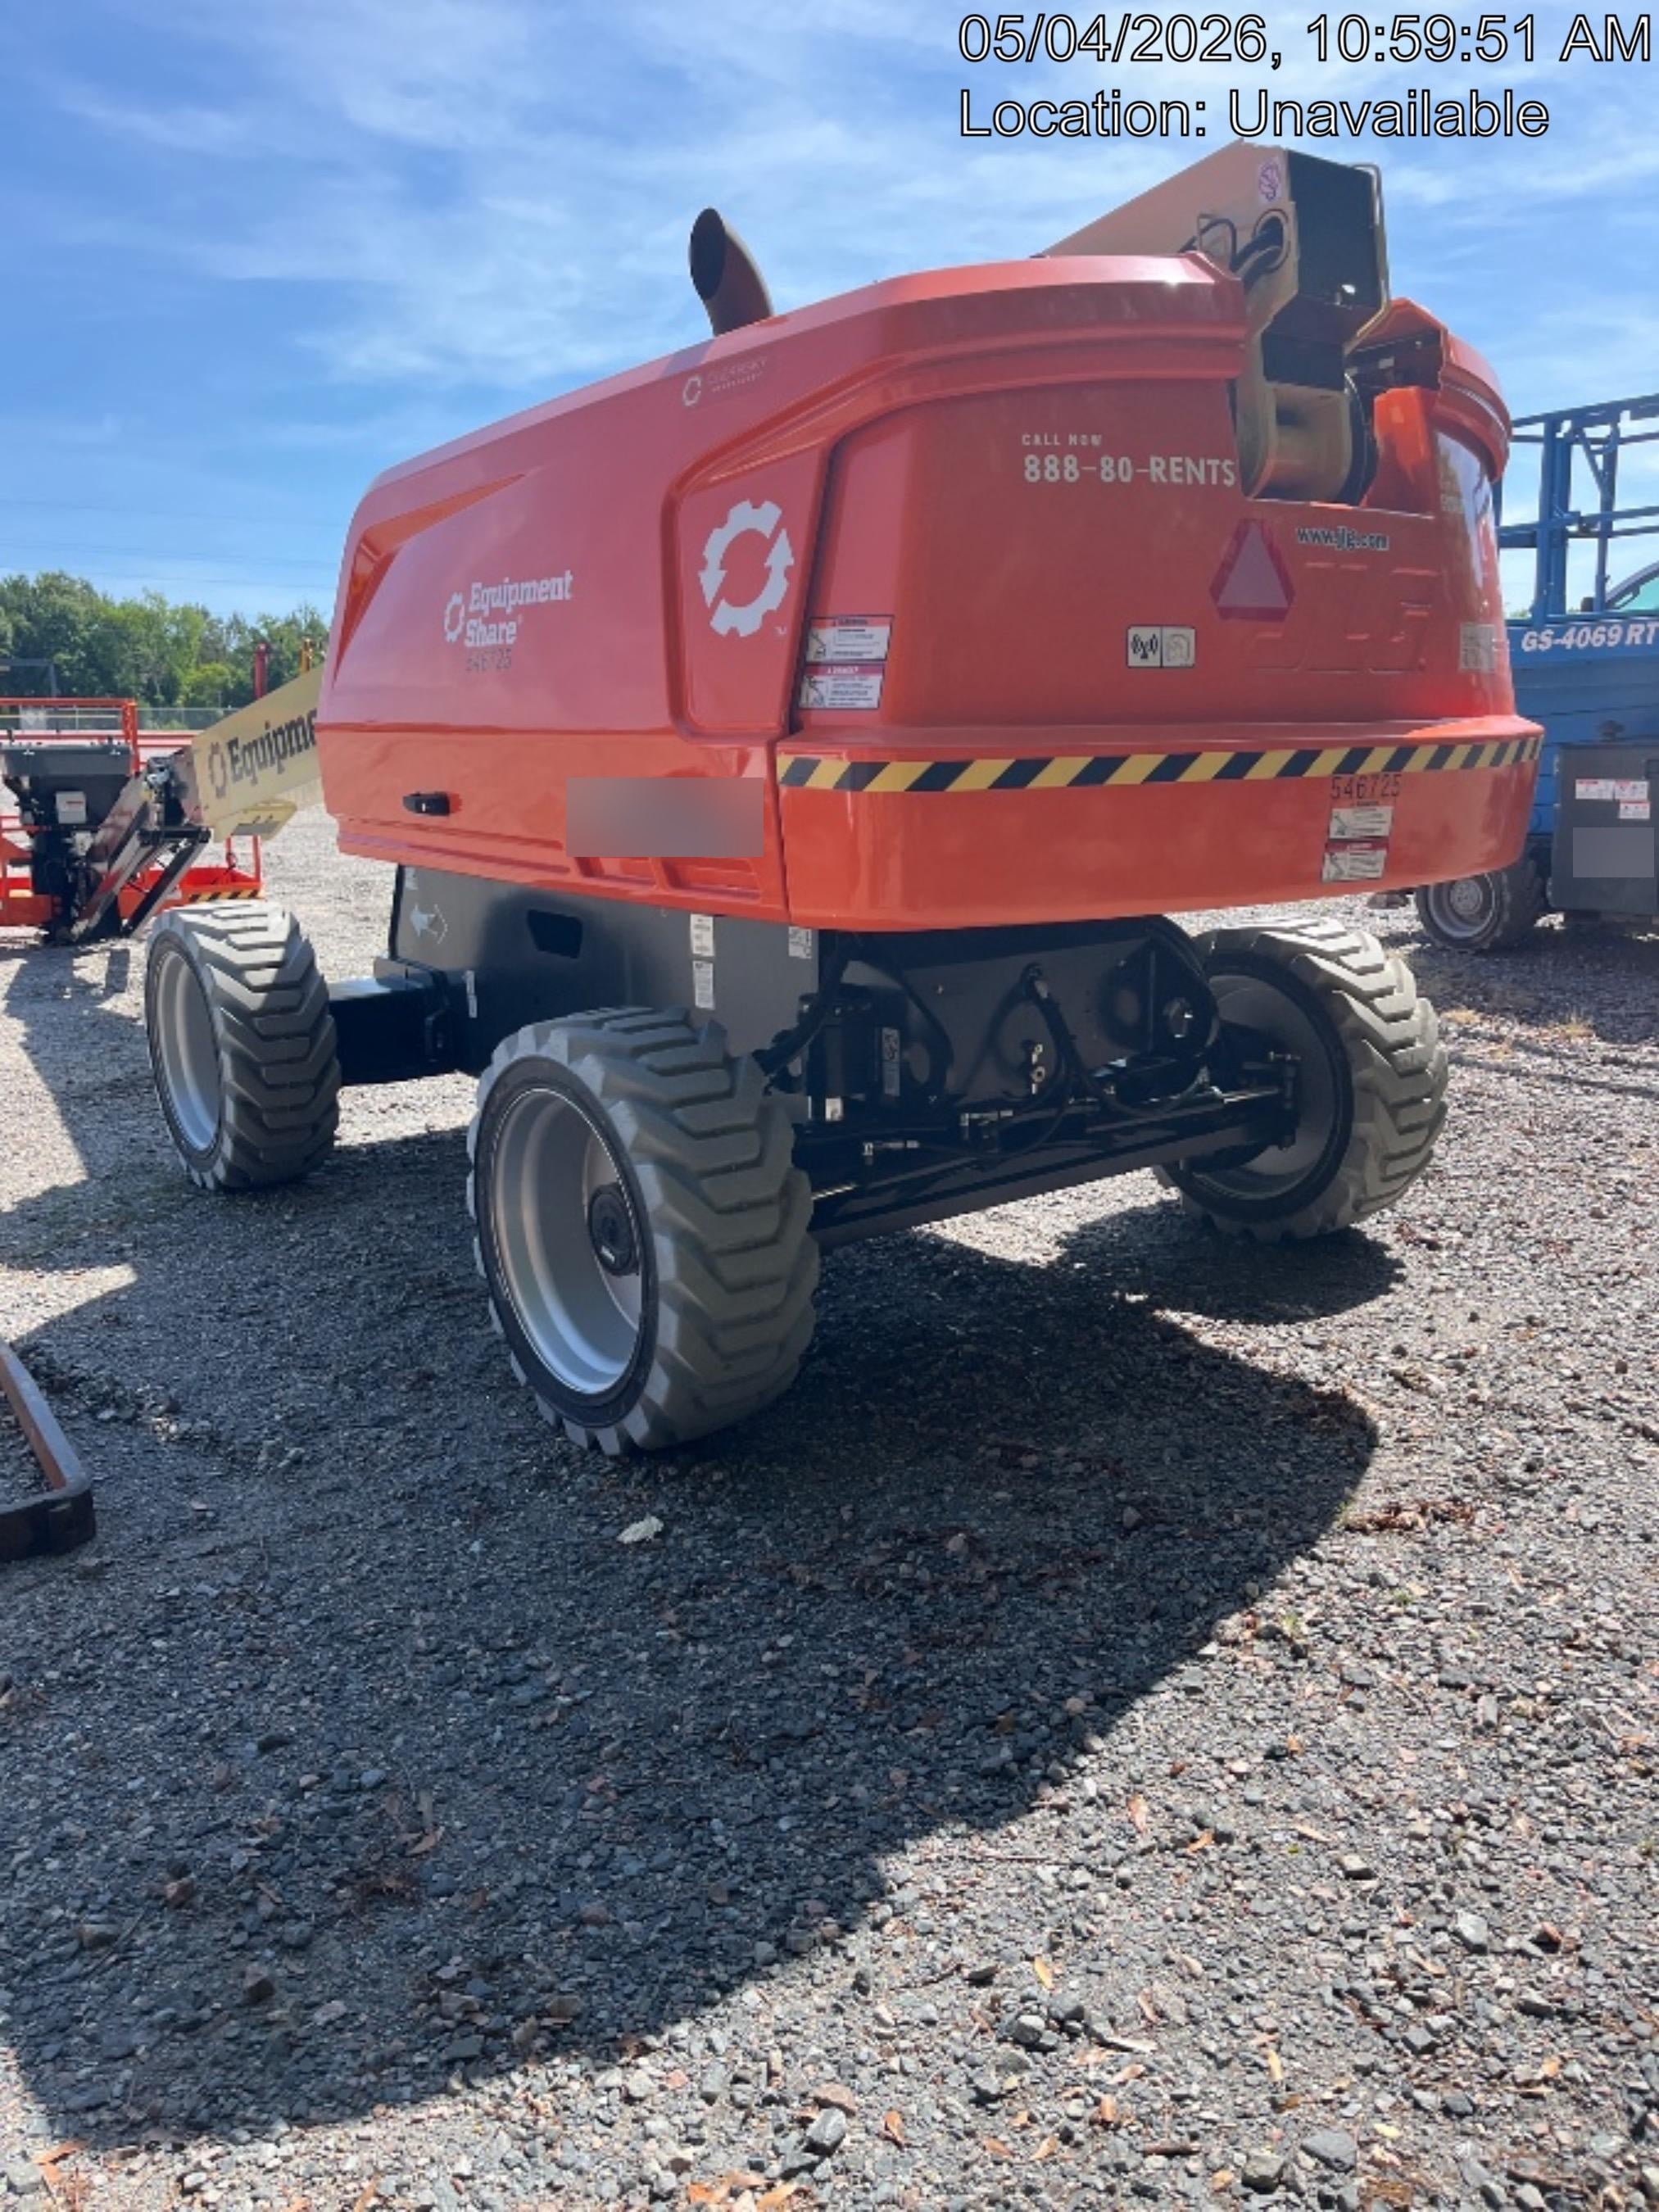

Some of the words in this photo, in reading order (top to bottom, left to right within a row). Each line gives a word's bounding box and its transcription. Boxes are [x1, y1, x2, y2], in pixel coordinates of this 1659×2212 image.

[1022, 434, 1061, 446] CALL
[1068, 434, 1102, 446] NOW
[1024, 454, 1236, 487] 888-80-RENTS
[468, 569, 573, 617] Equipment
[1521, 624, 1623, 652] GS-4069
[1625, 622, 1659, 646] RT
[1330, 773, 1402, 799] 546725
